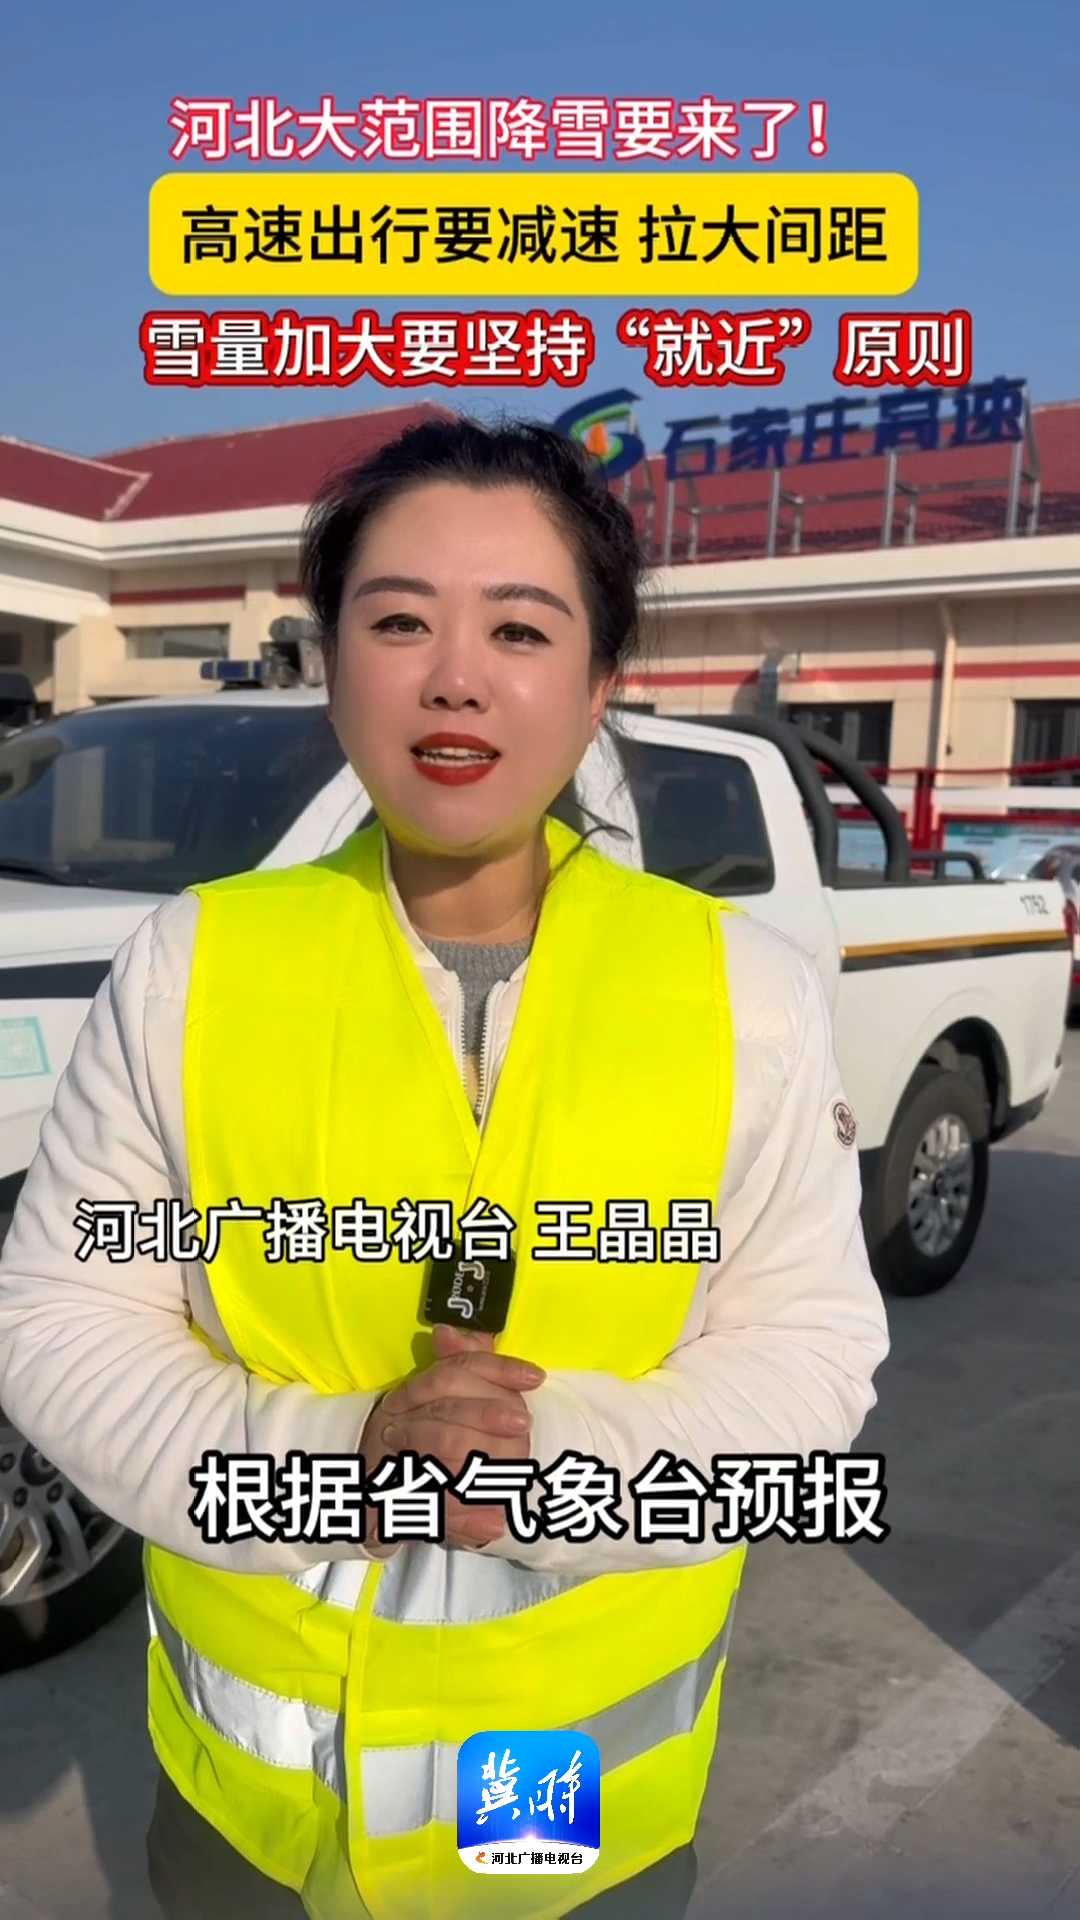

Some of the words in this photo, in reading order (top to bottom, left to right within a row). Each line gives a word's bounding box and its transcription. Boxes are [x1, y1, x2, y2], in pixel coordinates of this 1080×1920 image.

[665, 376, 1025, 480] 石家庄高速
